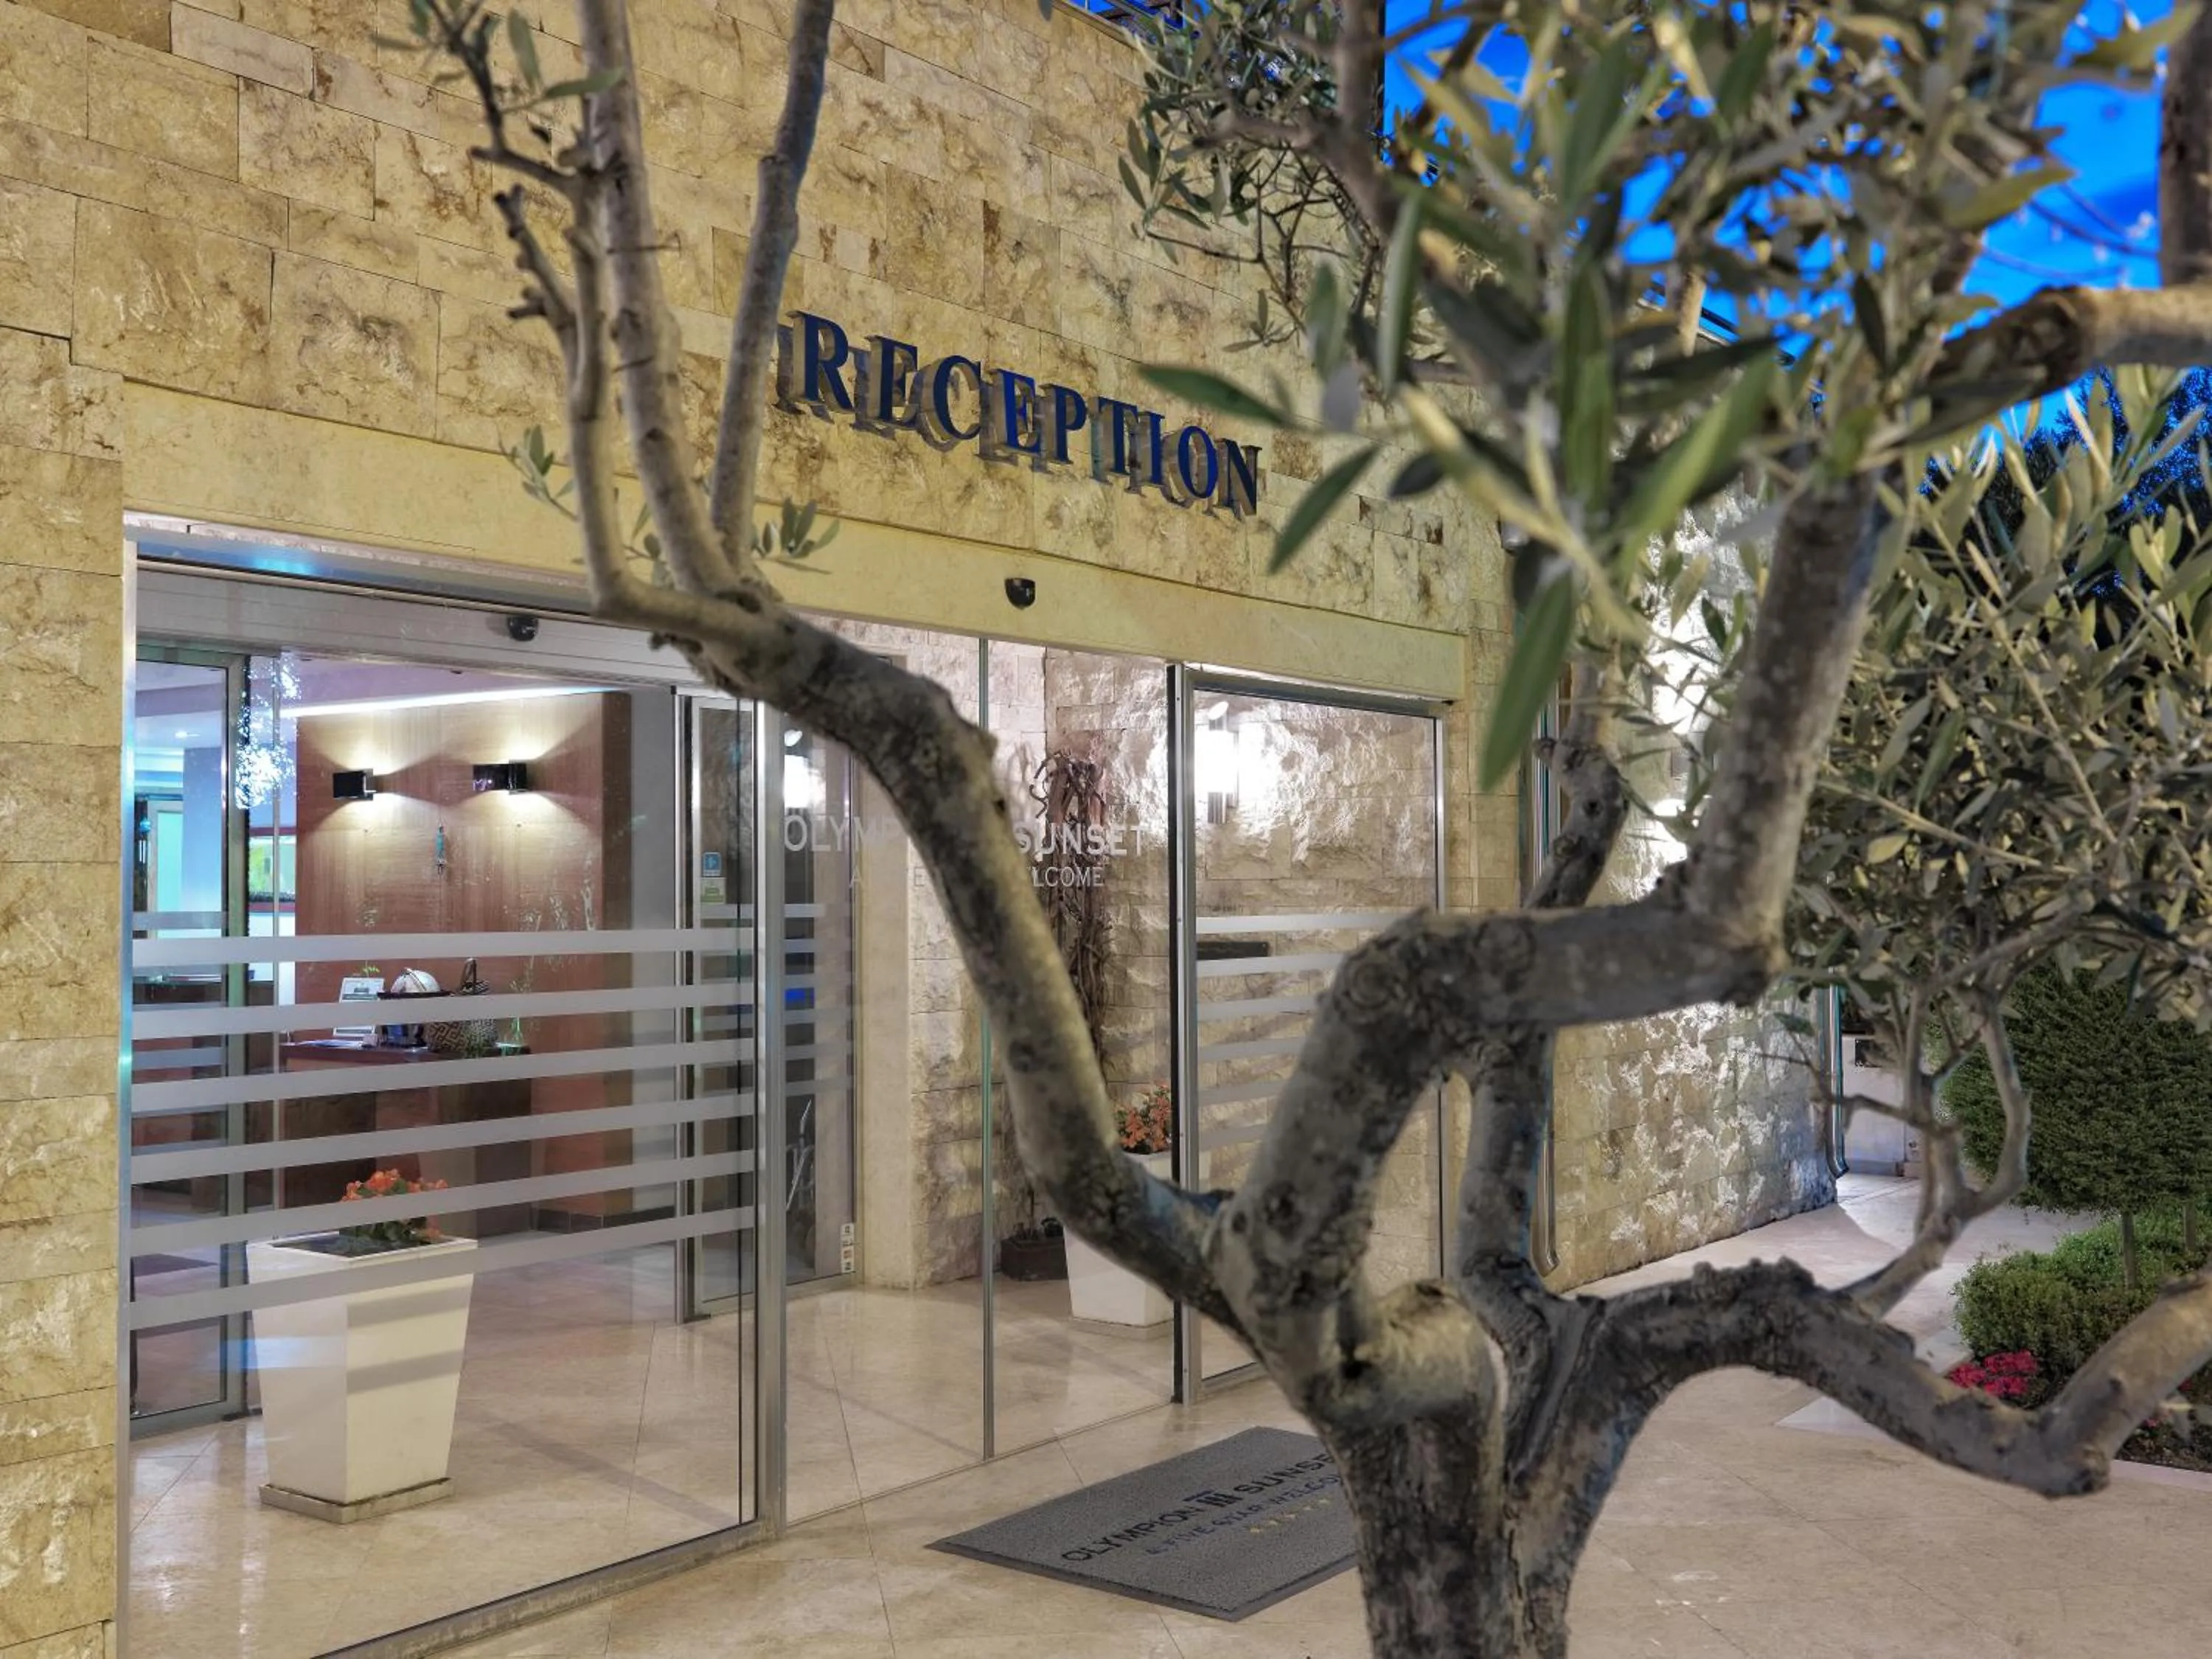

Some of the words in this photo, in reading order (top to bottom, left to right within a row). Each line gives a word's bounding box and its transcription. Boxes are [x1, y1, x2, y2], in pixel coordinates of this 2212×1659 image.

[782, 309, 1262, 517] RECEPTION
[784, 814, 902, 852] OLYMP
[1012, 822, 1144, 857] SUNSET
[1030, 866, 1105, 887] LCOME
[1061, 1505, 1206, 1561] OLYMPION
[1234, 1453, 1334, 1494] SUNSE
